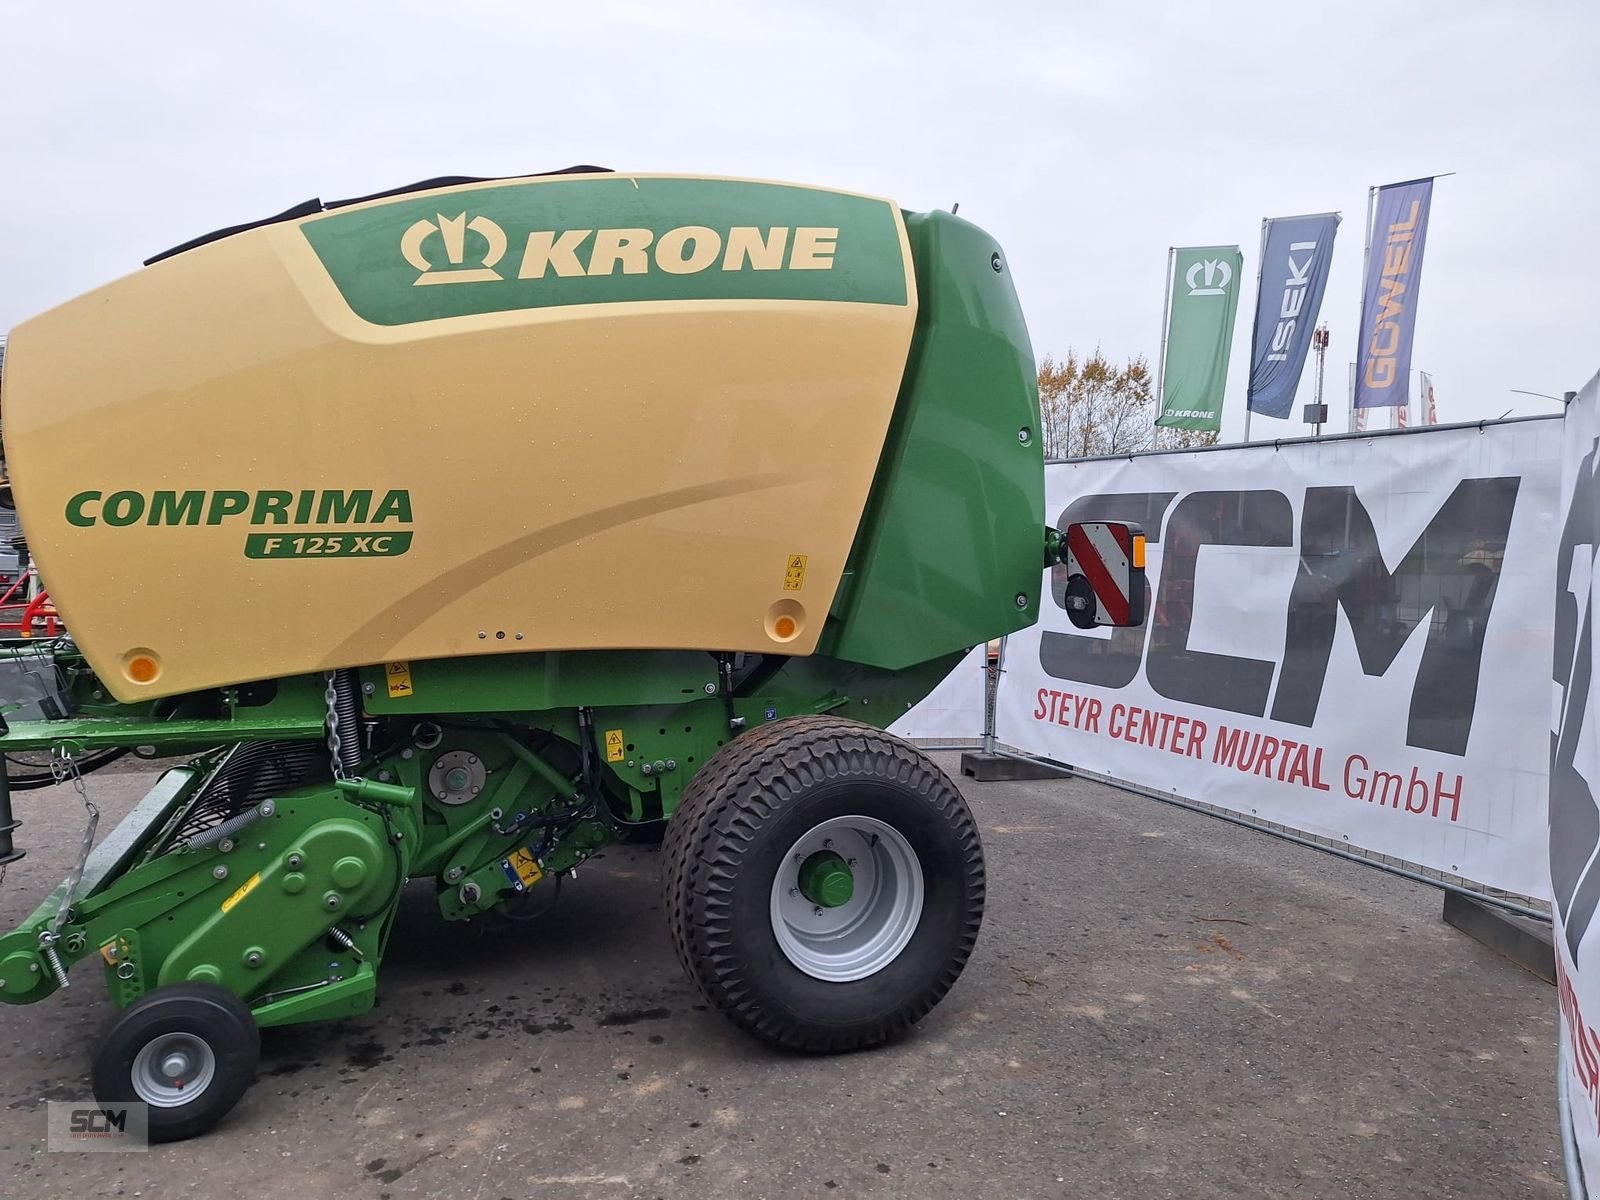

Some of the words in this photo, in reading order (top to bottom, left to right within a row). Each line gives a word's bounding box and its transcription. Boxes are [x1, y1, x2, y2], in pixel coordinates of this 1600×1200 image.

[517, 225, 839, 280] KRONE
[1267, 241, 1317, 361] ISEKI
[1174, 409, 1216, 419] KRONE
[64, 489, 414, 528] COMPRIMA
[263, 538, 282, 555] F
[292, 537, 343, 555] 125
[349, 536, 393, 554] XC
[1039, 476, 1522, 757] SCM
[1034, 688, 1103, 734] STEYR
[1108, 703, 1207, 760] CENTER
[1212, 725, 1331, 792] MURTAL
[1343, 754, 1463, 822] GmbH
